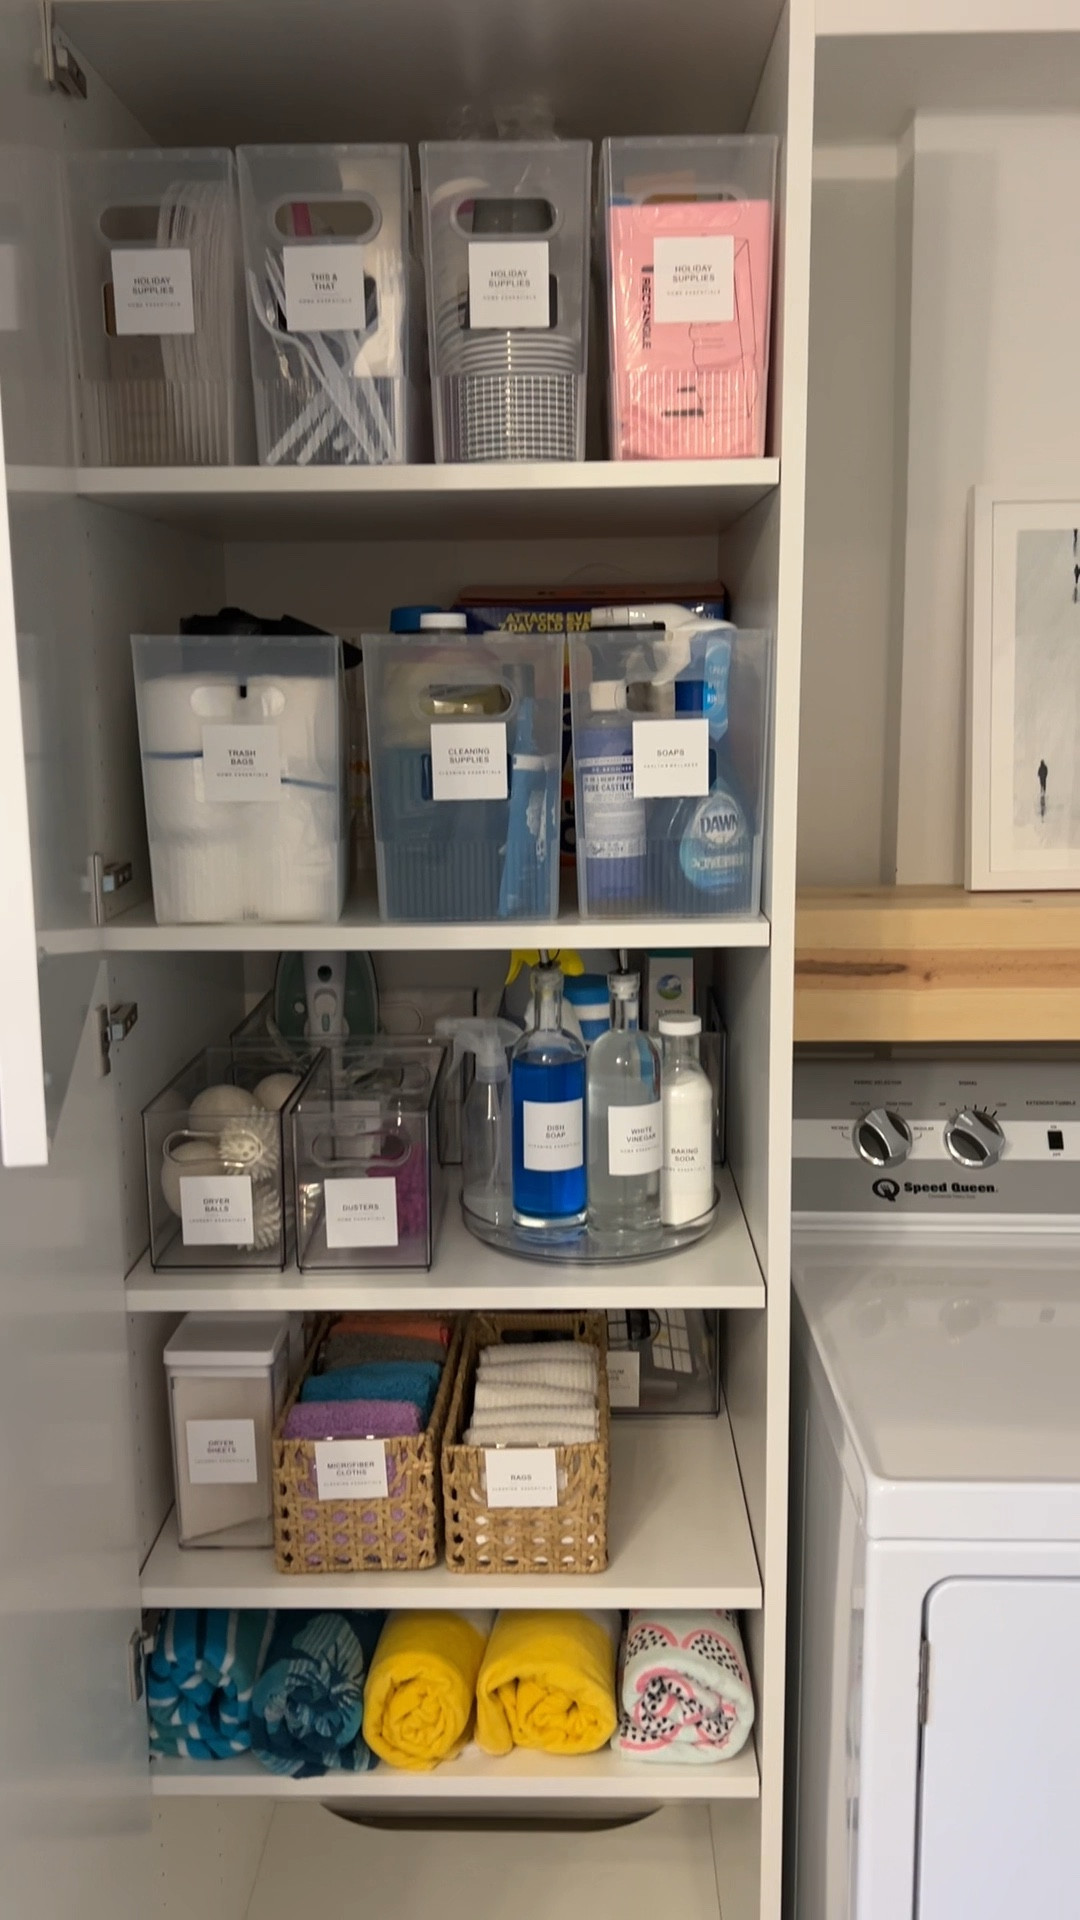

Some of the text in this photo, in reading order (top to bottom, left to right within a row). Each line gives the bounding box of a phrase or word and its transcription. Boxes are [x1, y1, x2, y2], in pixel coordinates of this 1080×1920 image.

[675, 265, 712, 273] HOLIDAY
[311, 273, 330, 282] THIS
[490, 270, 527, 278] HOLIDAY
[133, 277, 171, 285] HOLIDAY
[672, 275, 715, 283] SUPPLIES
[314, 282, 335, 291] THAT
[488, 280, 530, 288] SUPPLIES
[132, 286, 174, 295] SUPPLIES
[641, 277, 652, 350] RECTANGLE
[506, 612, 563, 624] ATTACKS
[508, 623, 534, 632] DAY
[537, 623, 563, 632] OLD
[228, 749, 256, 757] TRASH
[230, 758, 254, 766] BAGS
[449, 756, 490, 764] SUPPLIES
[700, 814, 740, 833] DAWN
[546, 1124, 565, 1132] DISH
[631, 1126, 652, 1135] WHITE
[626, 1133, 656, 1143] VINEGAR
[671, 1147, 699, 1155] BAKING
[904, 1182, 947, 1194] Speed
[951, 1182, 995, 1193] Queen
[327, 1461, 375, 1469] MICROFIBER
